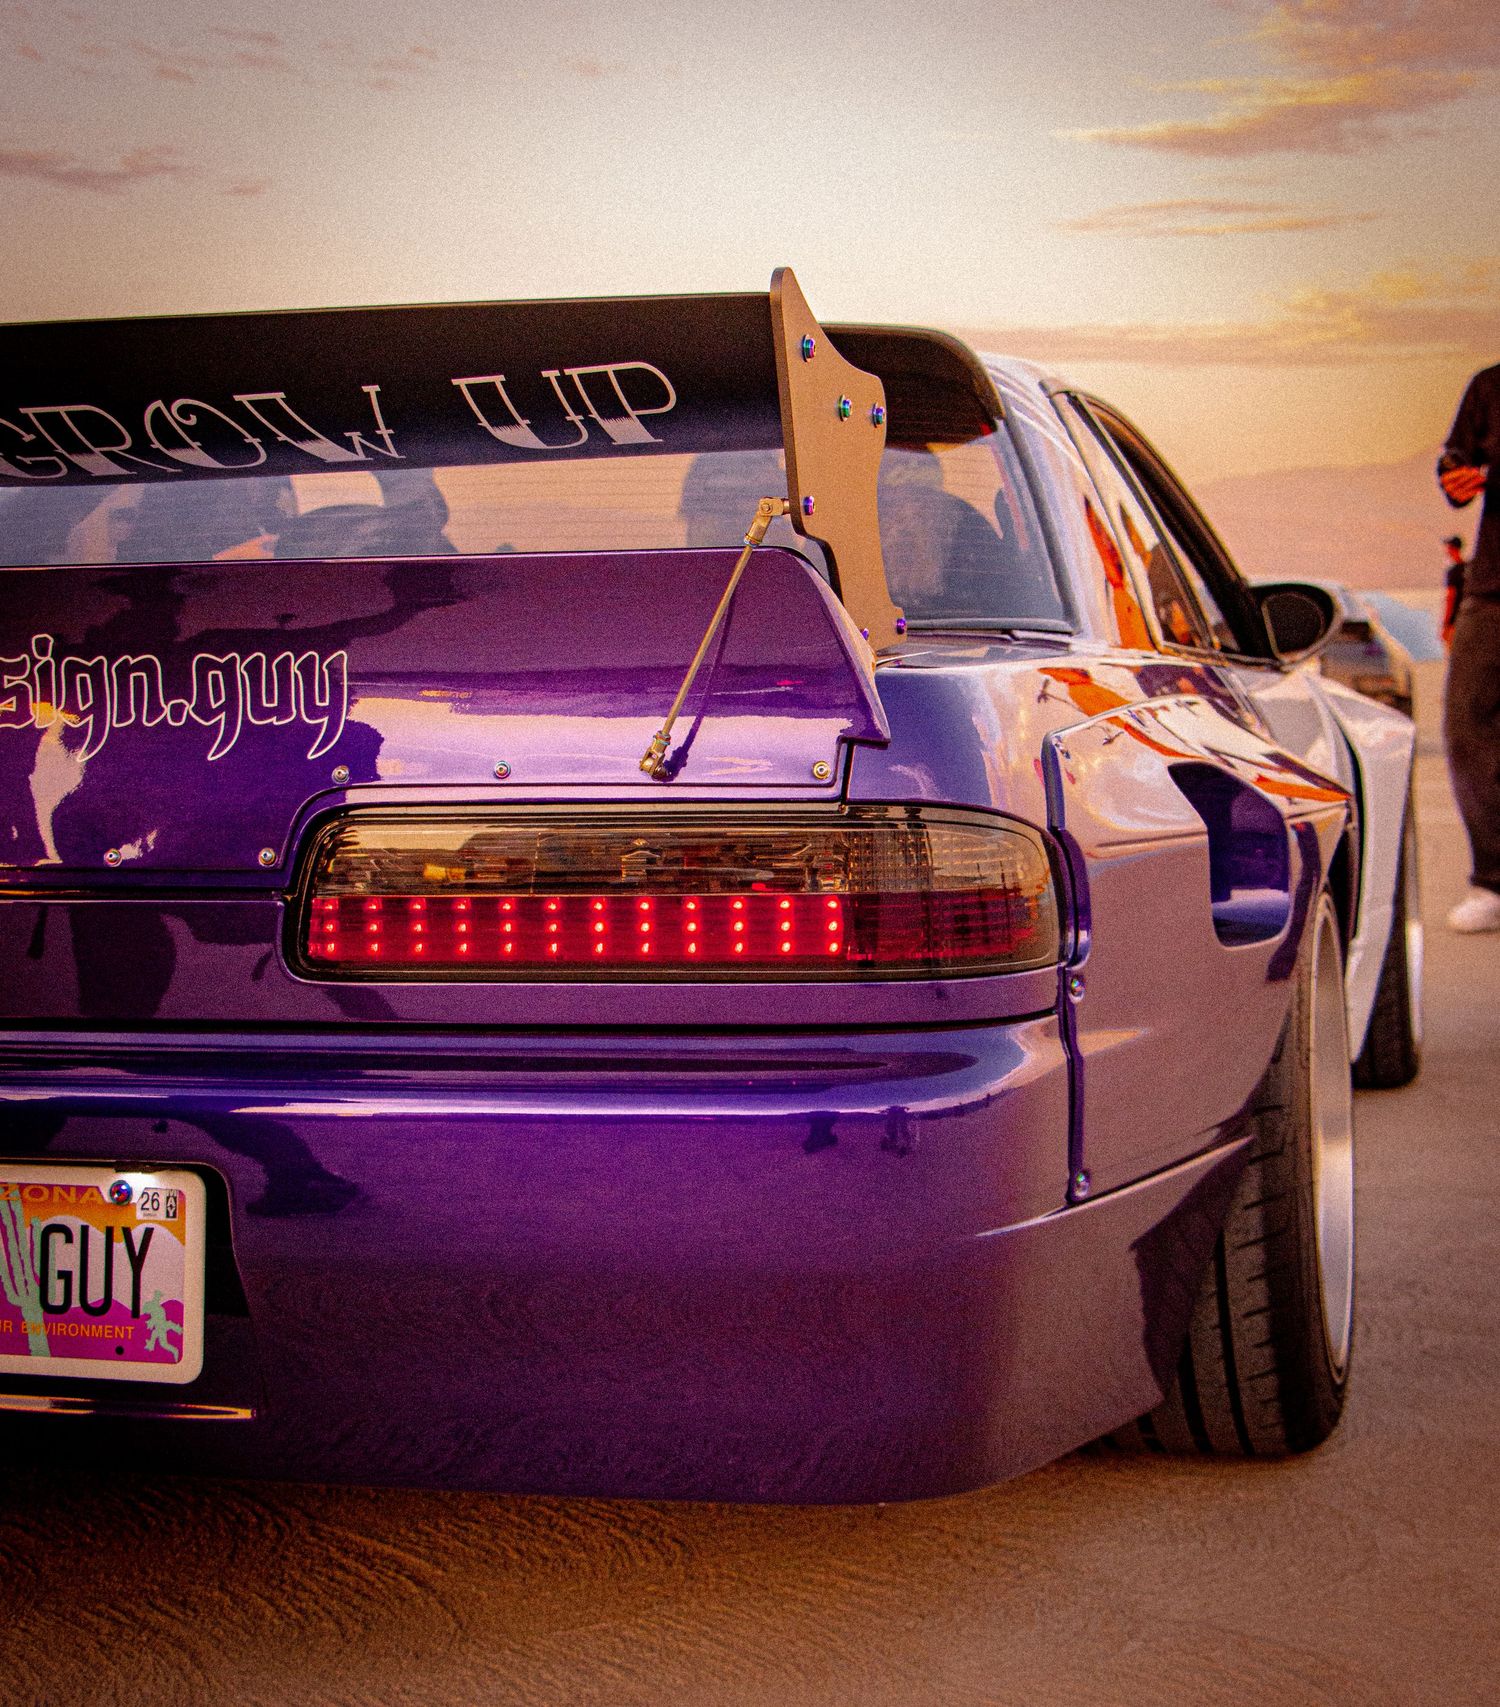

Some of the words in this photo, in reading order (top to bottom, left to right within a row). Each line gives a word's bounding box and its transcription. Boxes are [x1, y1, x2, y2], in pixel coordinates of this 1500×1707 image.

[451, 361, 677, 449] UP
[140, 1191, 160, 1211] 26
[40, 1223, 154, 1319] GUY
[21, 1321, 135, 1339] ENVIRONMENT
